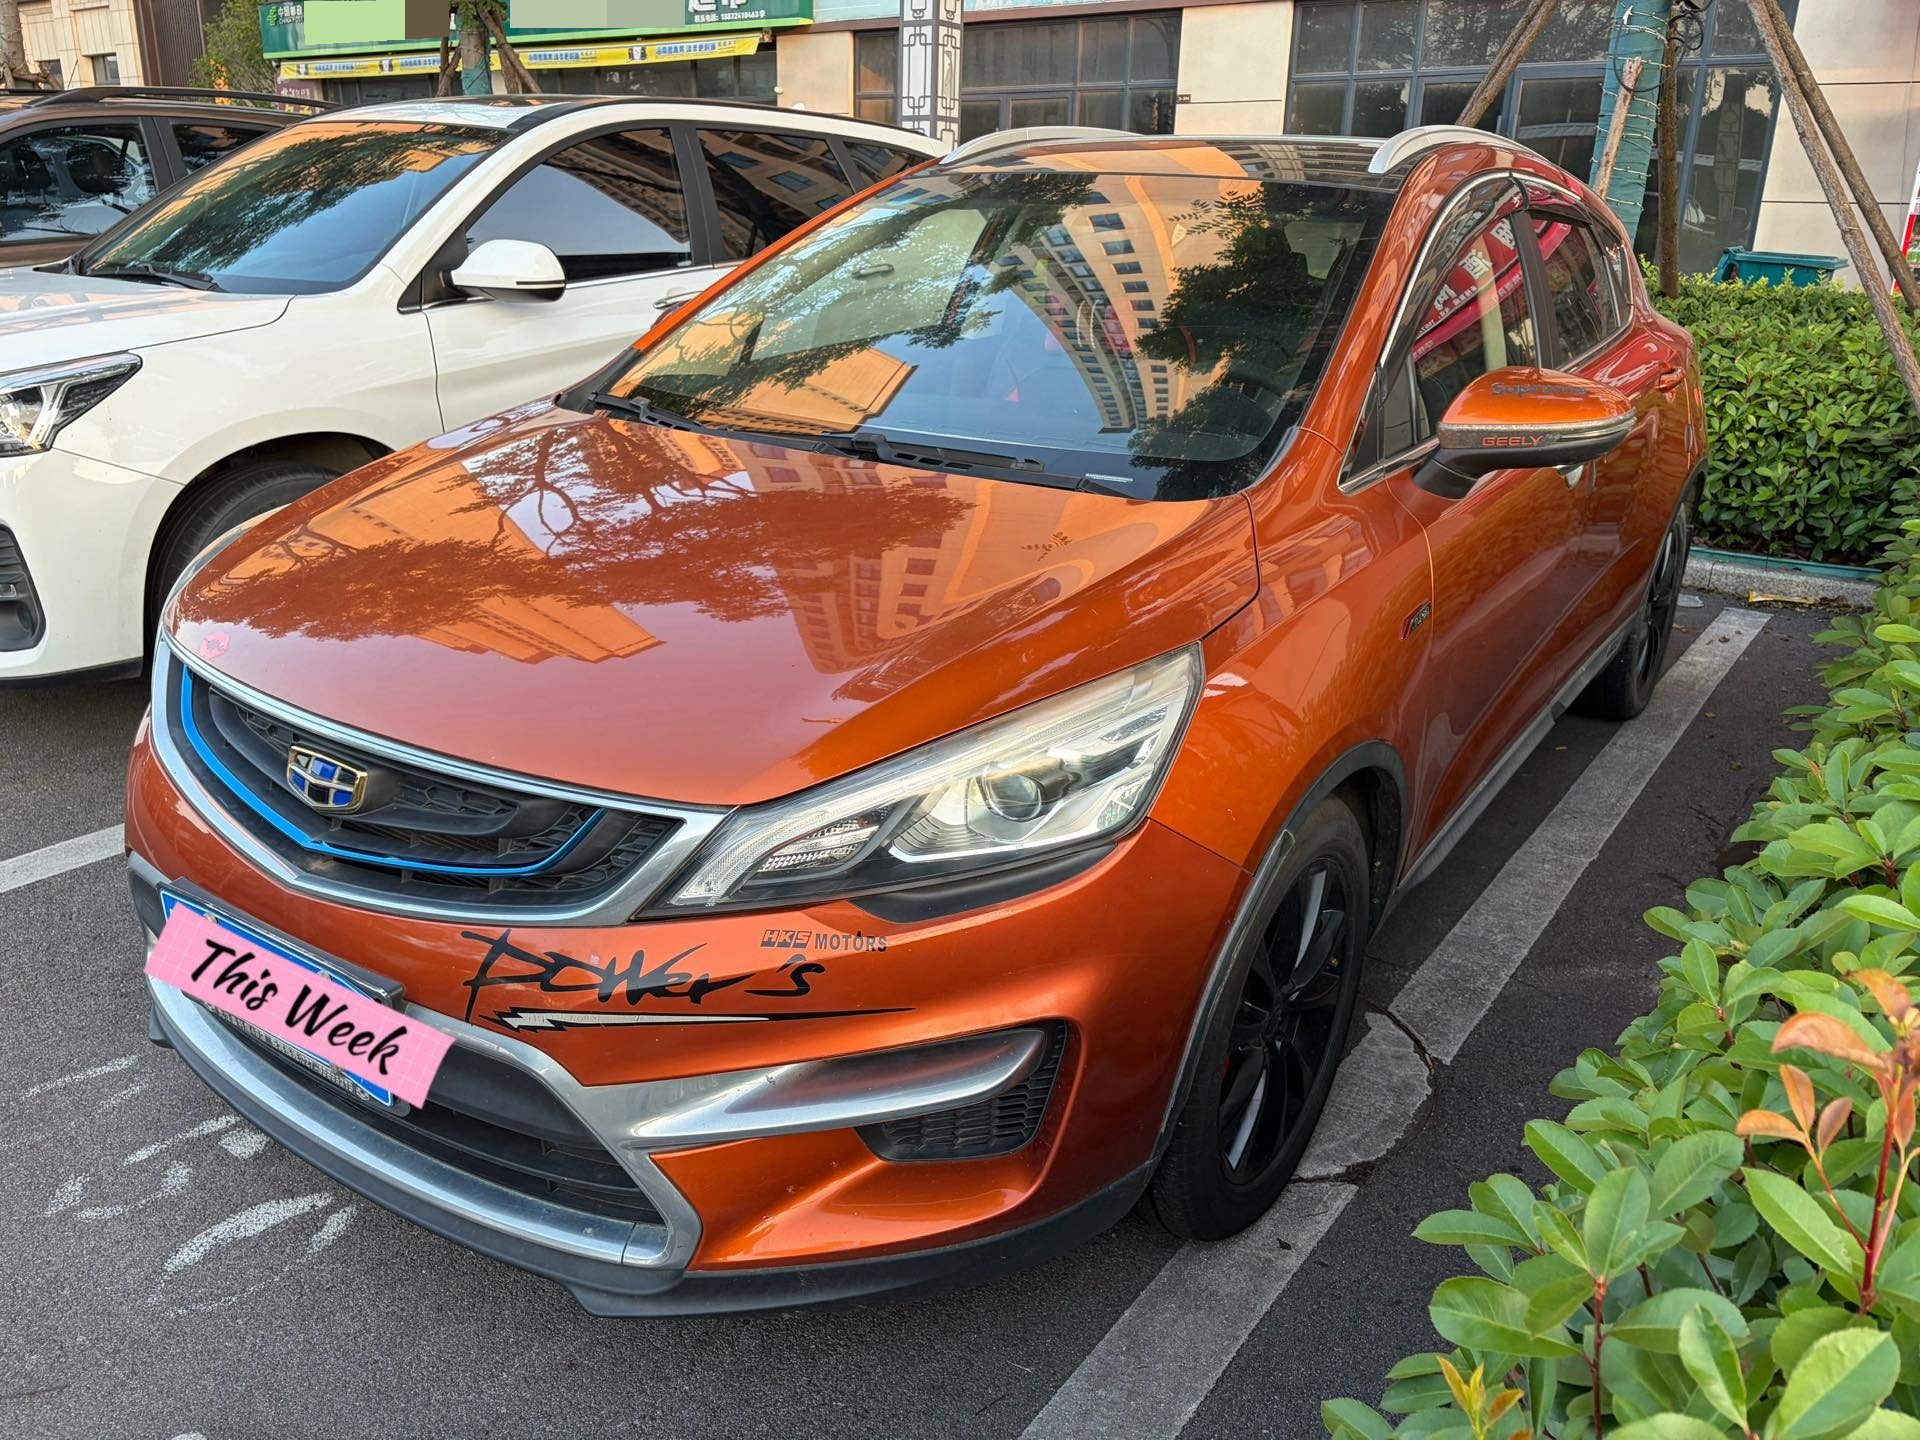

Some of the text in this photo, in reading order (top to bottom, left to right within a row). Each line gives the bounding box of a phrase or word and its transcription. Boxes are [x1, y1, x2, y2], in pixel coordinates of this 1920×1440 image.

[1482, 436, 1543, 447] GEELY
[760, 929, 888, 952] HKS MOTORS
